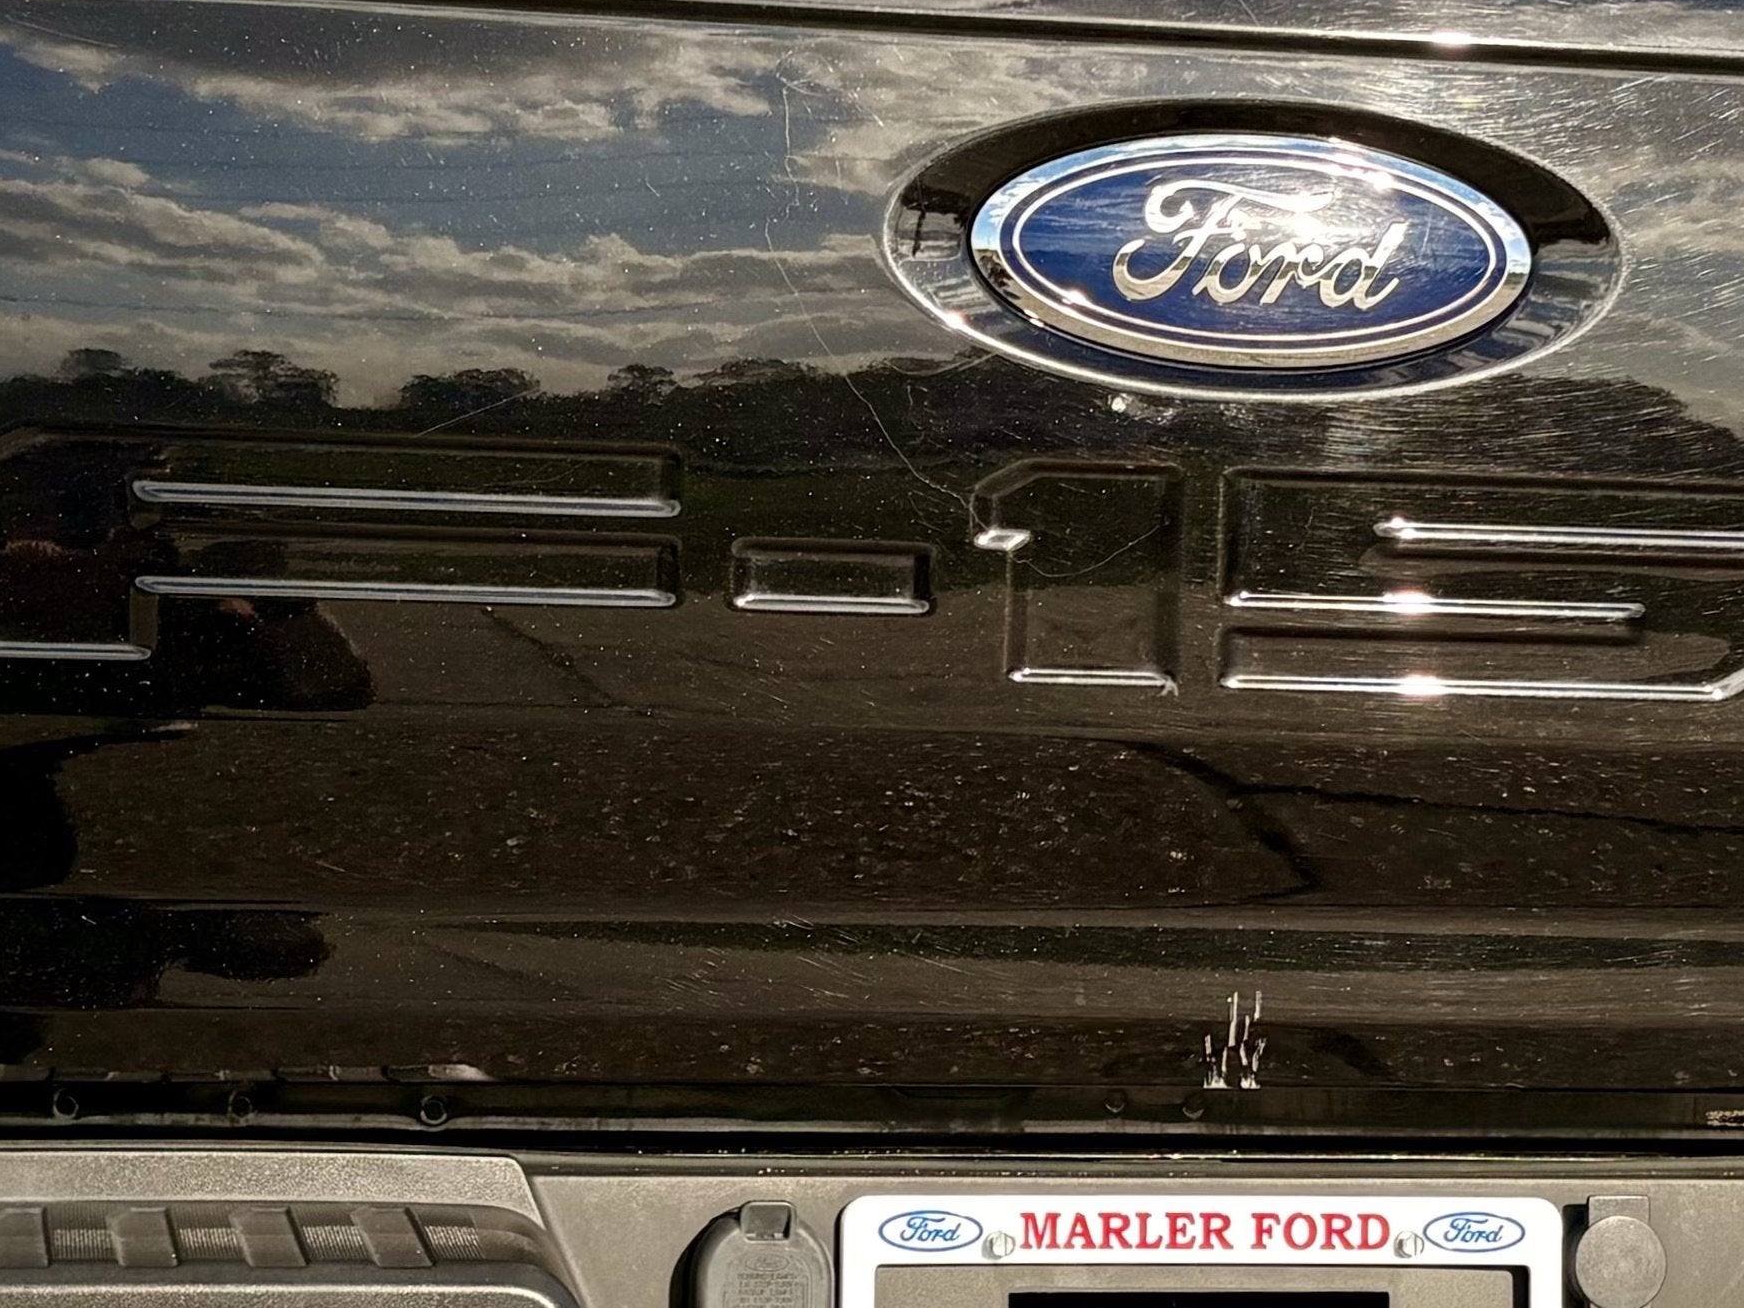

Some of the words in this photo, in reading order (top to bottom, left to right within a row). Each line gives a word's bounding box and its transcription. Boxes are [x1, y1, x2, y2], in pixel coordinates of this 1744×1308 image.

[1111, 177, 1409, 312] Ford
[899, 1216, 962, 1243] Ford
[1019, 1211, 1235, 1250] MARLER
[1250, 1211, 1391, 1251] FORD
[1443, 1217, 1504, 1243] Ford
